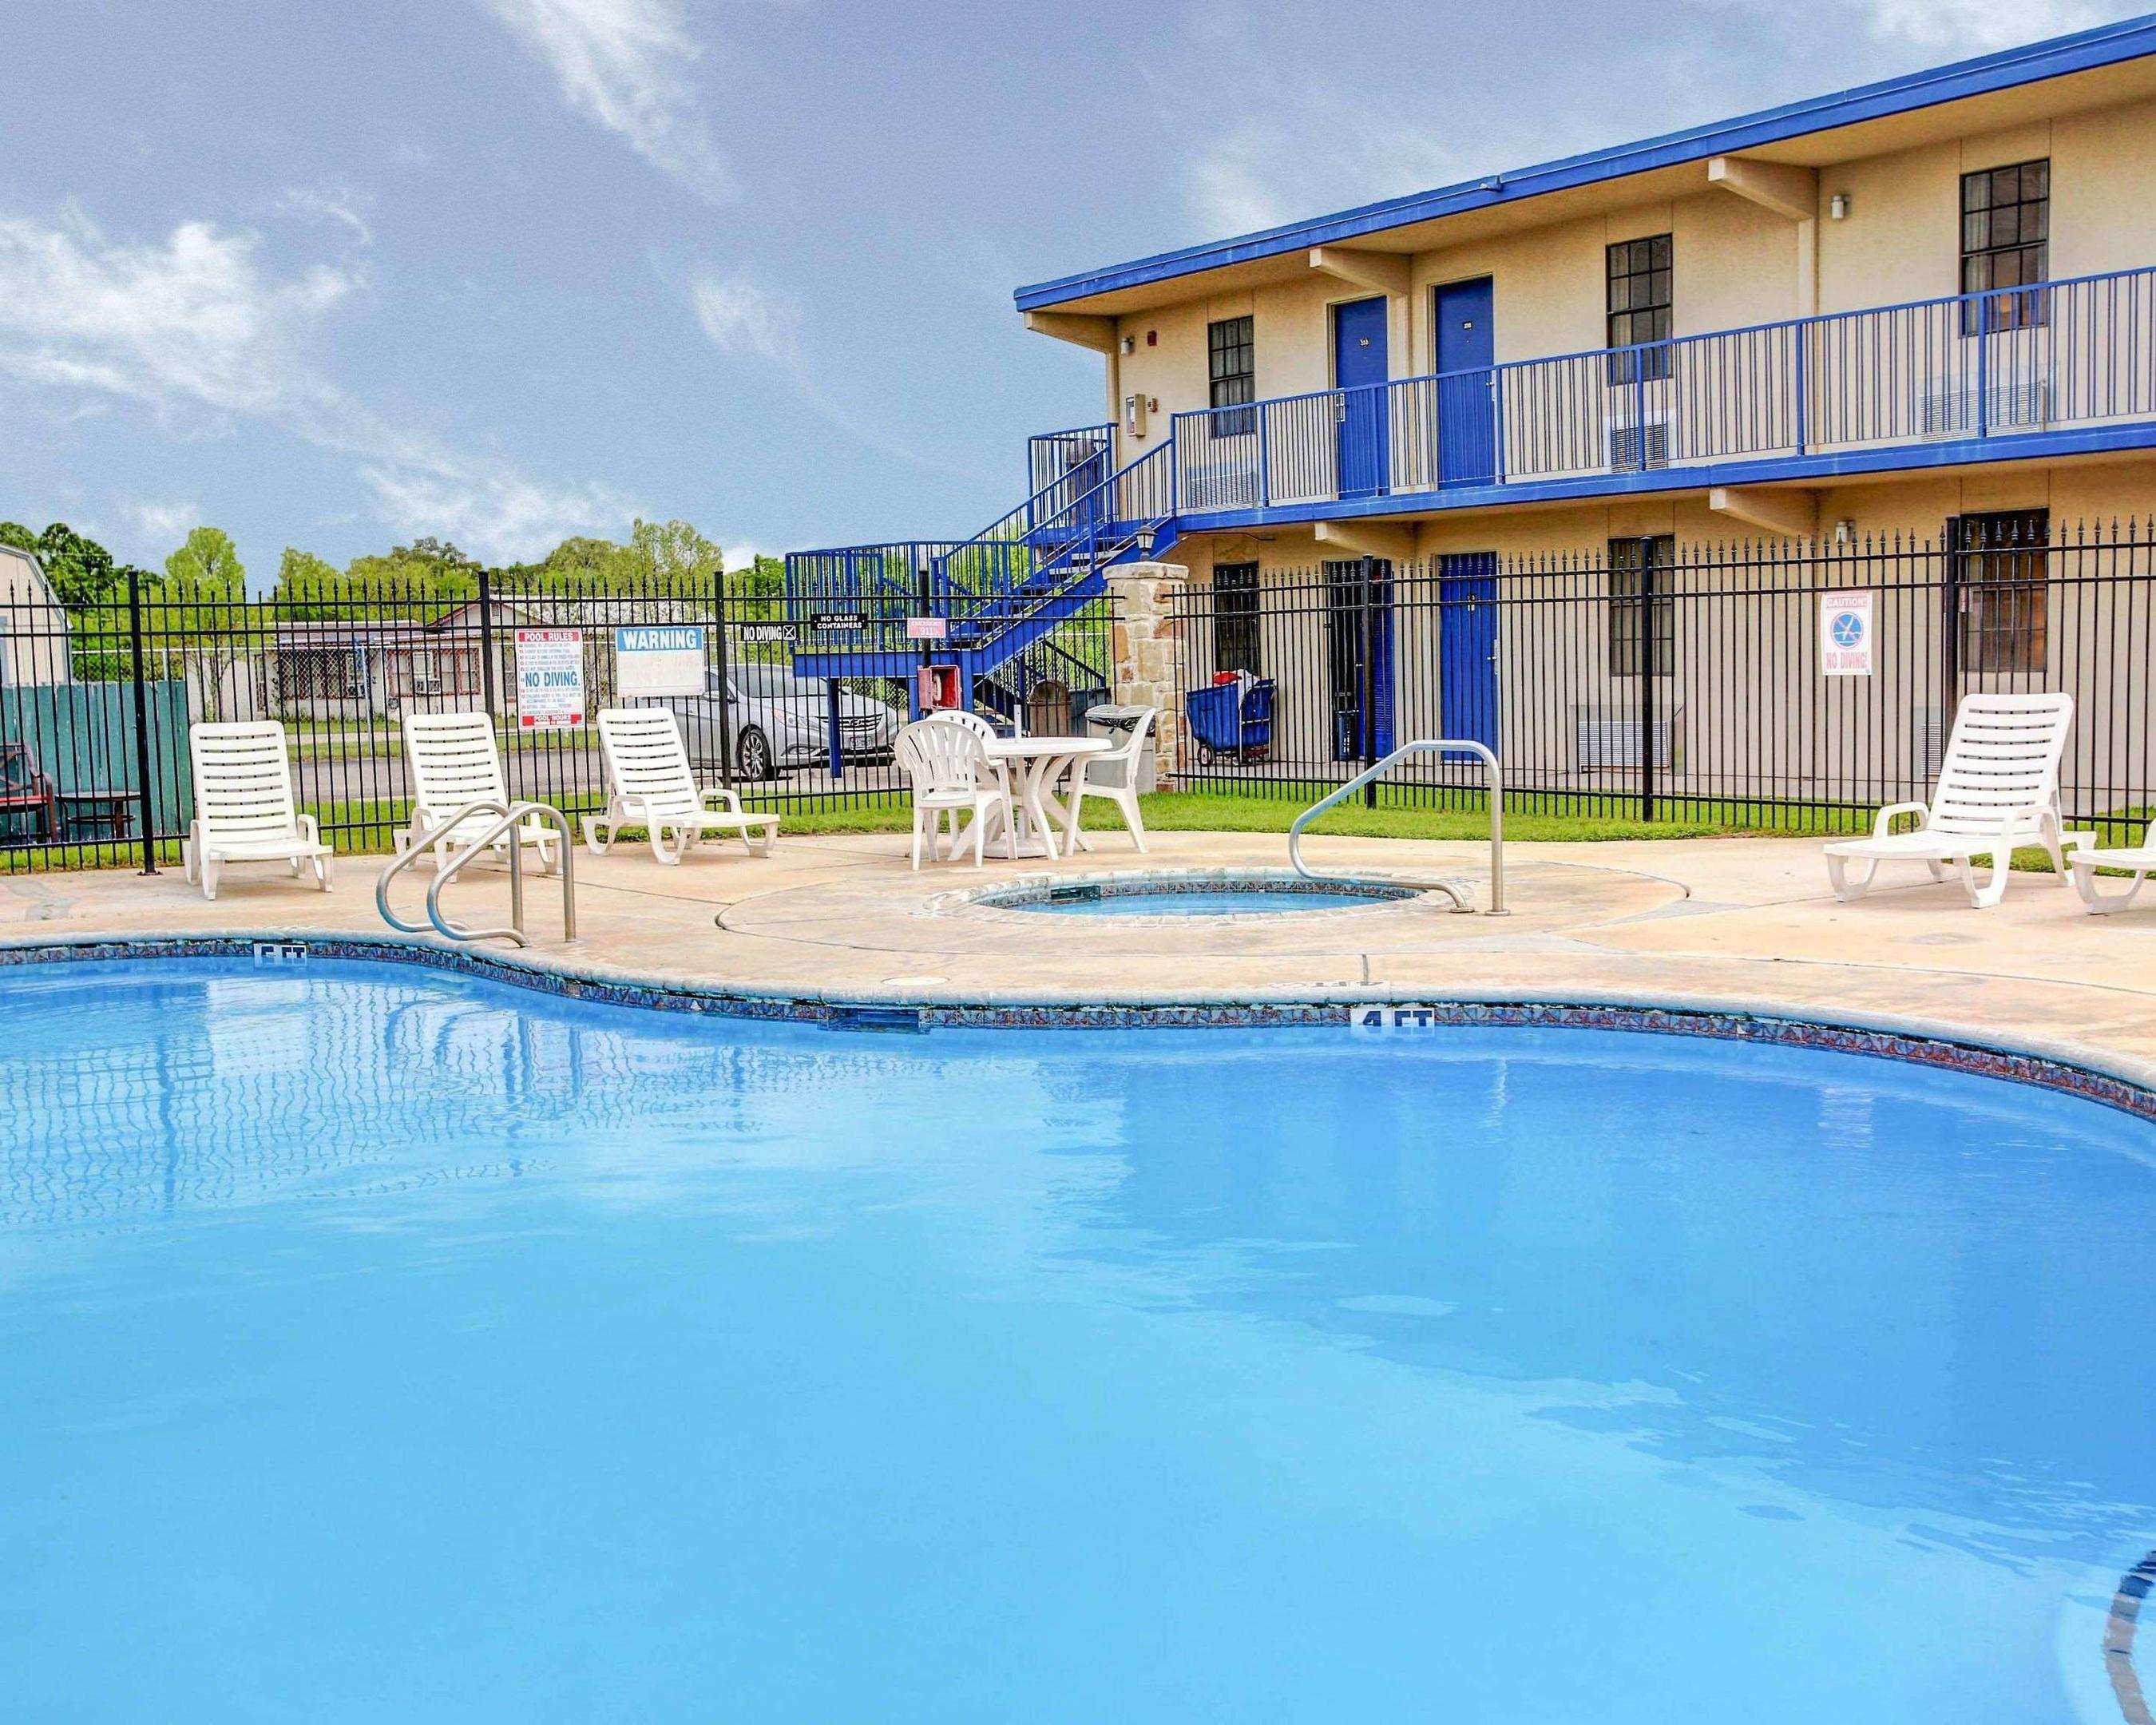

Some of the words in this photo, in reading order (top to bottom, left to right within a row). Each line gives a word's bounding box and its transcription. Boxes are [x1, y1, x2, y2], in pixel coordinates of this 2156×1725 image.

[1826, 597, 1867, 607] CAUTION!
[525, 632, 545, 642] POOL
[549, 632, 573, 642] RULES
[622, 629, 697, 649] WARNING
[743, 626, 755, 640] NO
[756, 625, 783, 640] DIVING
[1825, 652, 1837, 669] NO
[1840, 652, 1868, 669] DIVING!
[525, 672, 540, 687] NO
[544, 671, 581, 687] DIVING.
[1362, 1010, 1381, 1027] 4
